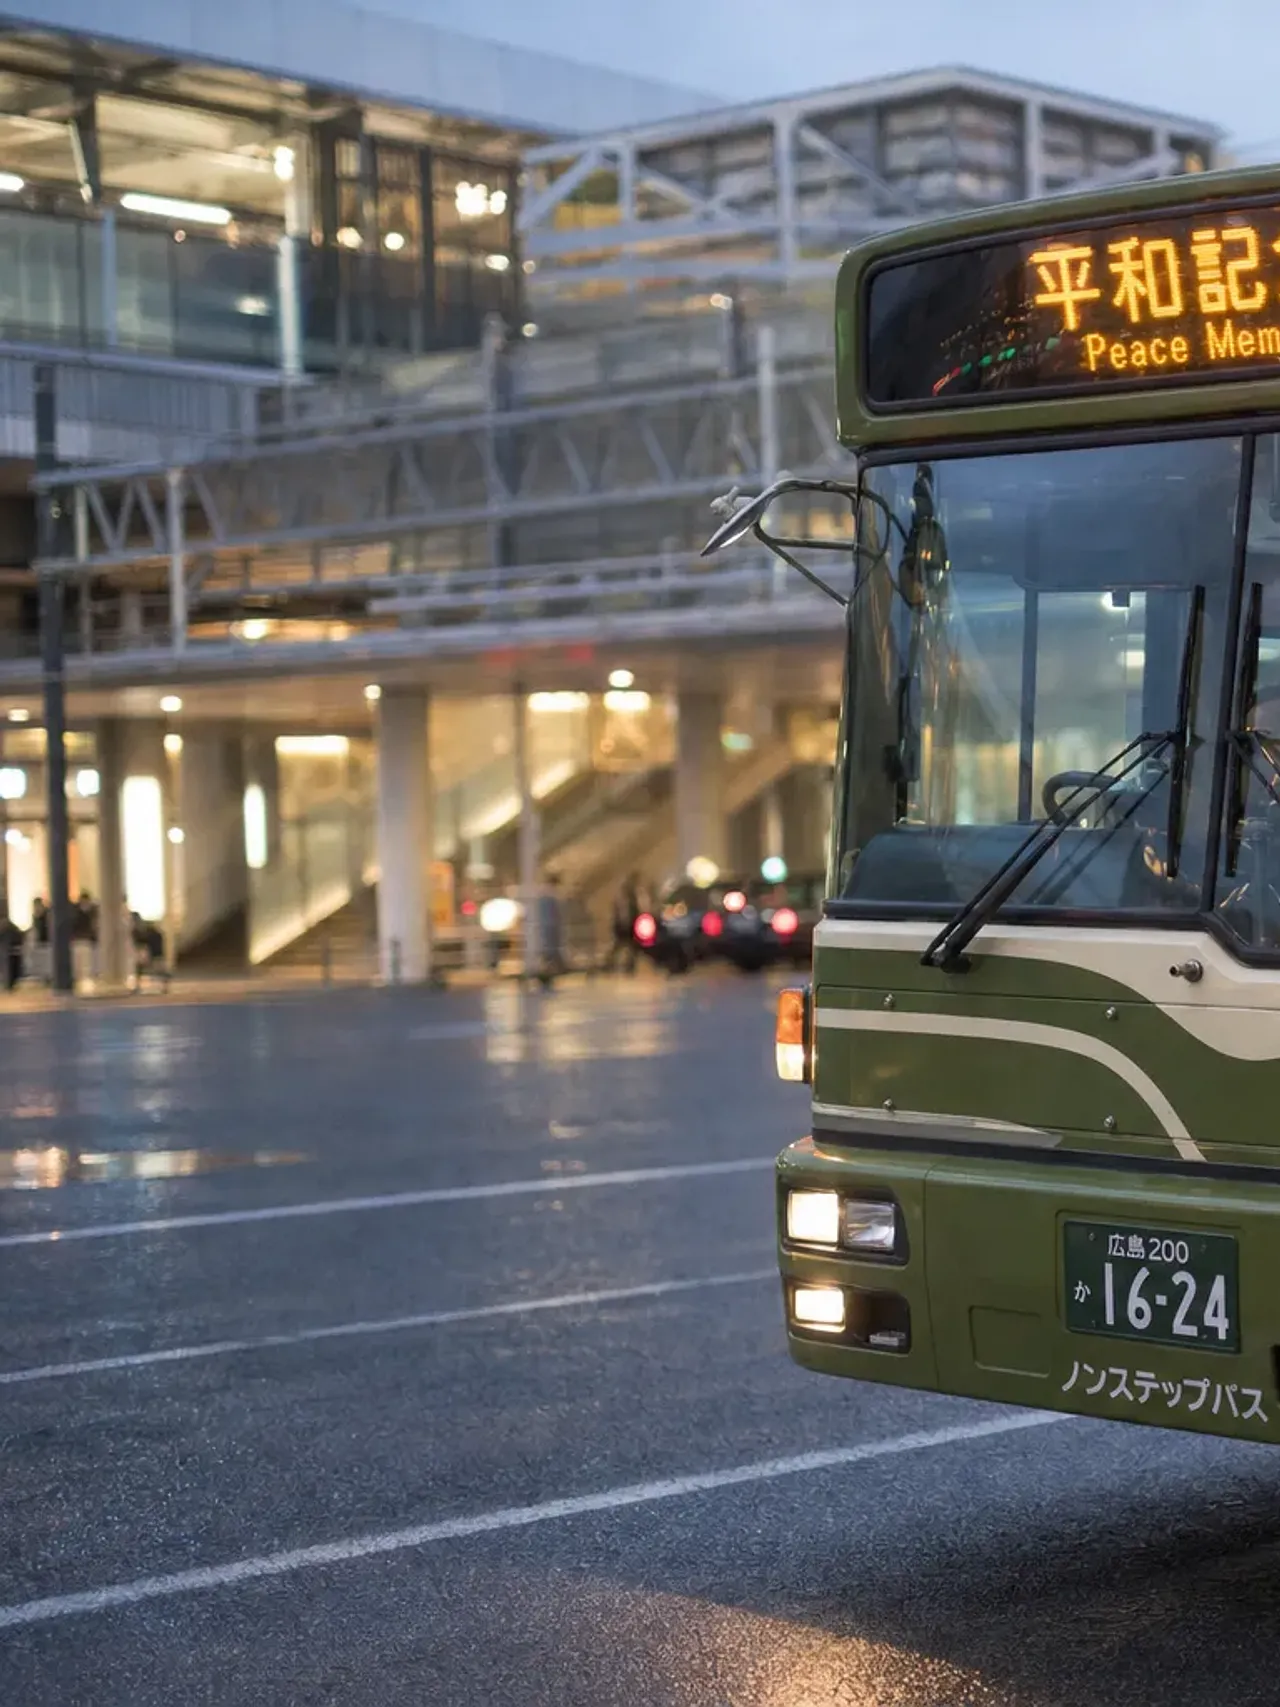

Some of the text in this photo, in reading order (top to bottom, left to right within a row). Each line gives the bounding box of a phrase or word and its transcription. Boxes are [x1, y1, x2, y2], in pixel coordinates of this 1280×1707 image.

[1083, 333, 1189, 372] Peace
[1074, 1262, 1230, 1340] か 16-24
